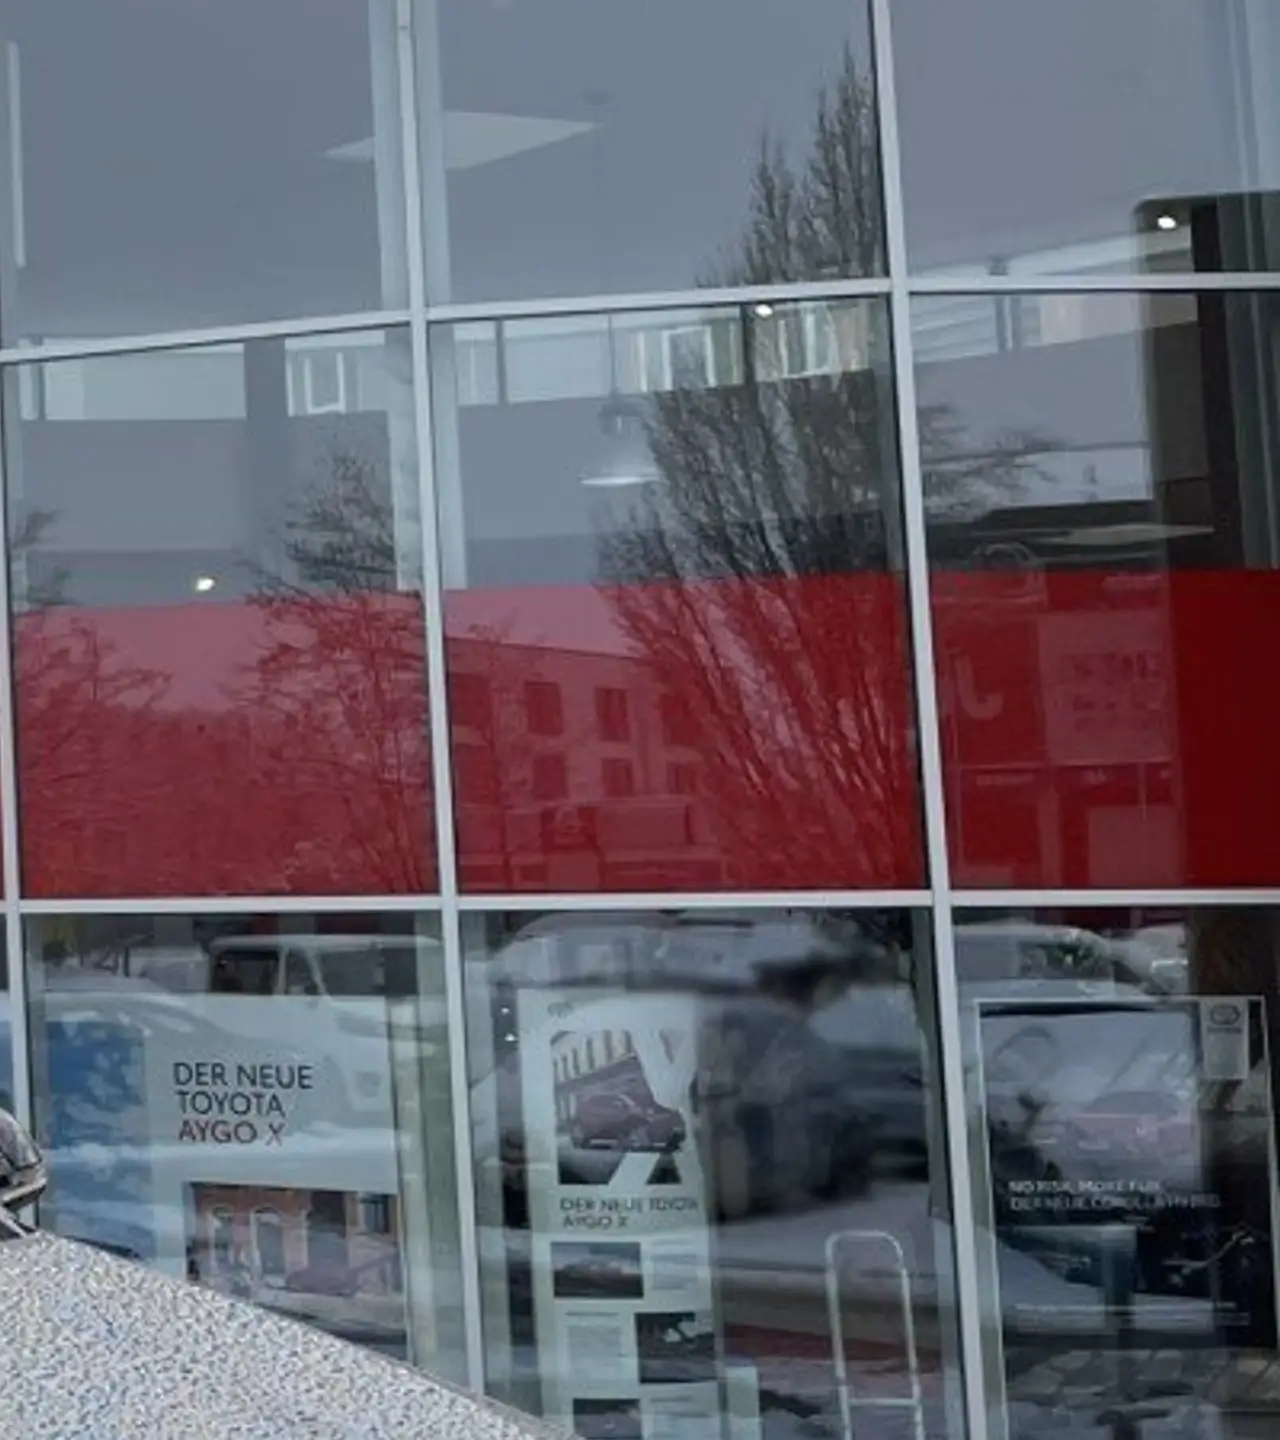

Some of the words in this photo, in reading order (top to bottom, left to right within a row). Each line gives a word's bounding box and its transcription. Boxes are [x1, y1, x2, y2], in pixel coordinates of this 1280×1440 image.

[173, 1061, 228, 1087] DER
[237, 1063, 315, 1090] NEUE
[175, 1090, 286, 1118] TOYOTA
[178, 1119, 258, 1145] AYGO
[265, 1122, 287, 1147] X
[559, 1197, 595, 1212] DER
[598, 1198, 644, 1213] NEUE
[563, 1215, 612, 1229] AYGO
